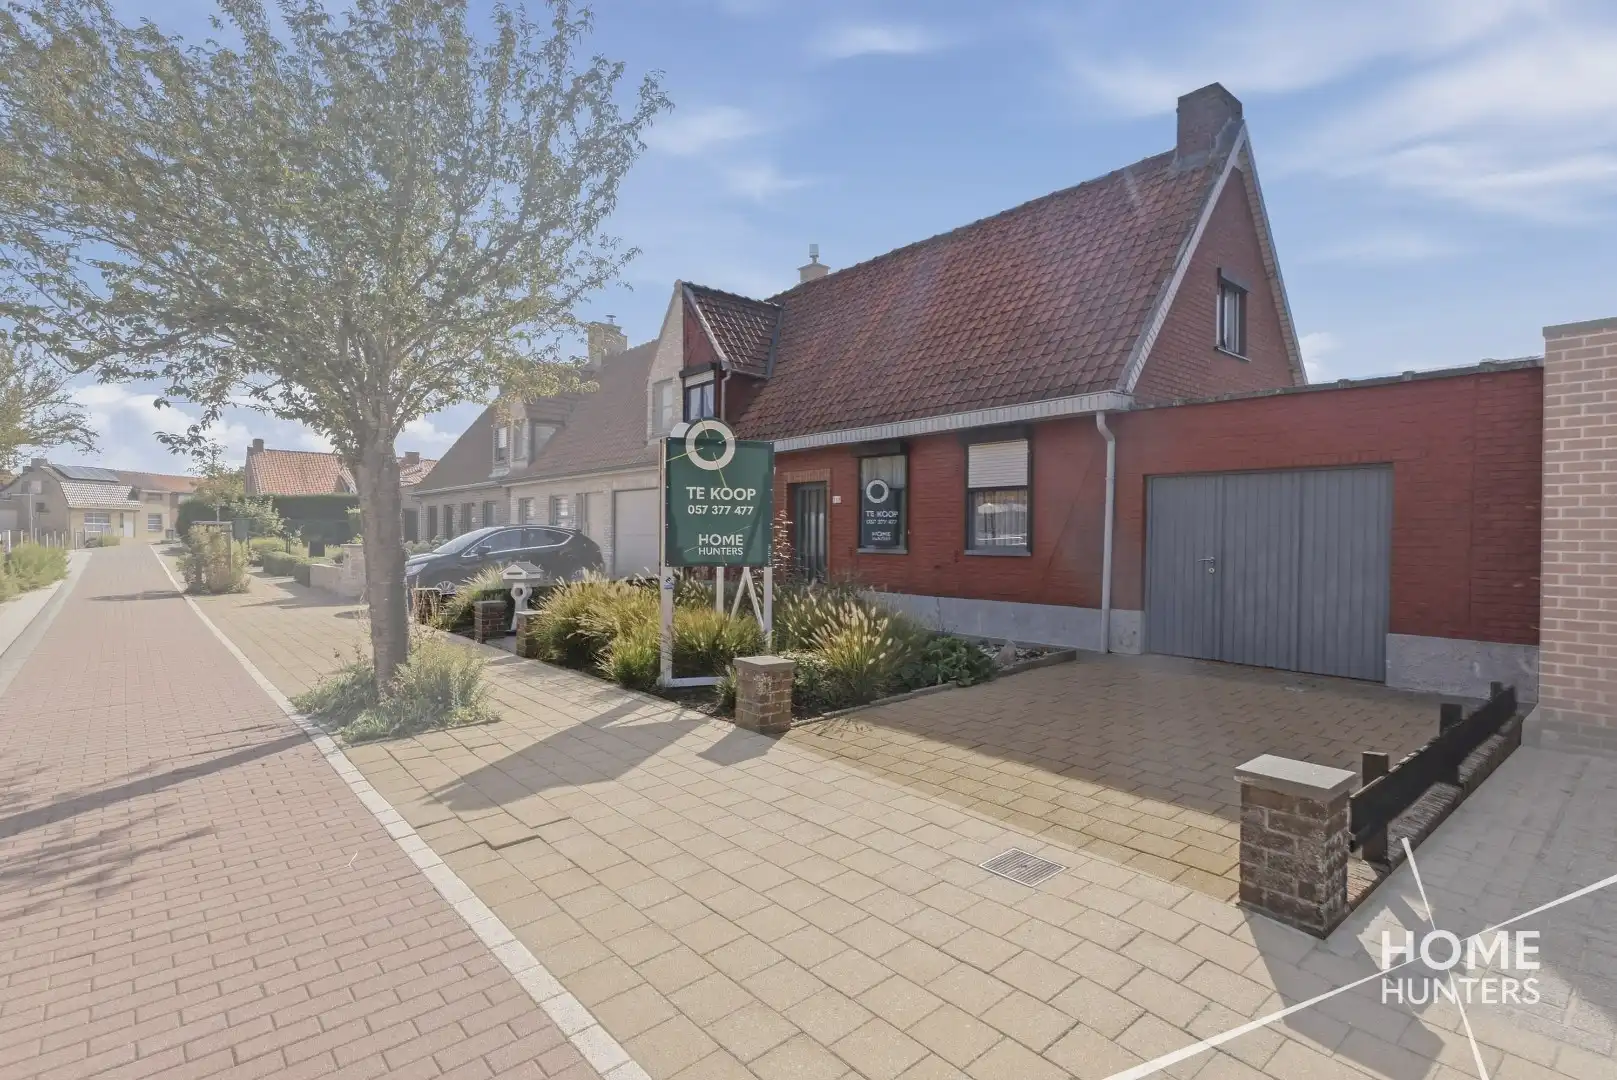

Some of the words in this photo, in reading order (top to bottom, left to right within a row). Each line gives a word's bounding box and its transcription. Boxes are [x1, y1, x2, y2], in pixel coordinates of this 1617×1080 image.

[686, 486, 705, 500] TE
[710, 487, 756, 501] KOOP
[688, 504, 708, 515] 057
[711, 505, 731, 515] 377
[734, 506, 754, 515] 477
[698, 533, 744, 546] HOME
[698, 547, 744, 556] HUNTERS
